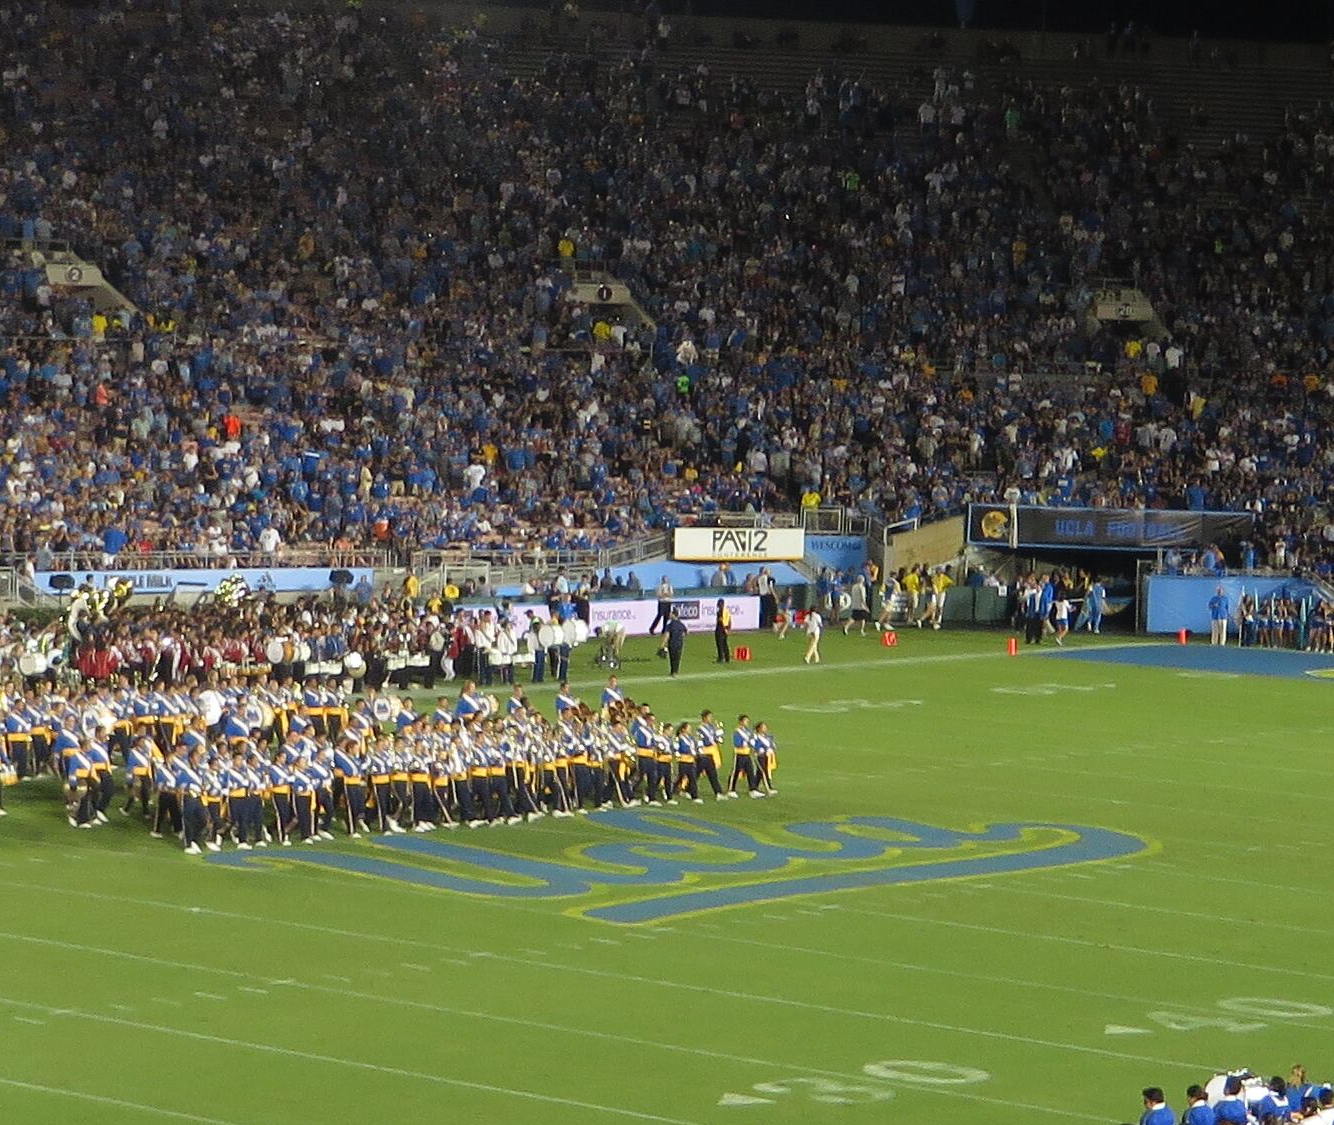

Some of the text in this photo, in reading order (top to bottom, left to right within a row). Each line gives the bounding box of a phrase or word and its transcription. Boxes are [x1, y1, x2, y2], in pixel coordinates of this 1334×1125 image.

[1054, 518, 1097, 537] UCLA
[701, 603, 741, 617] Insunce
[736, 647, 749, 660] 10
[751, 1059, 991, 1104] 30
